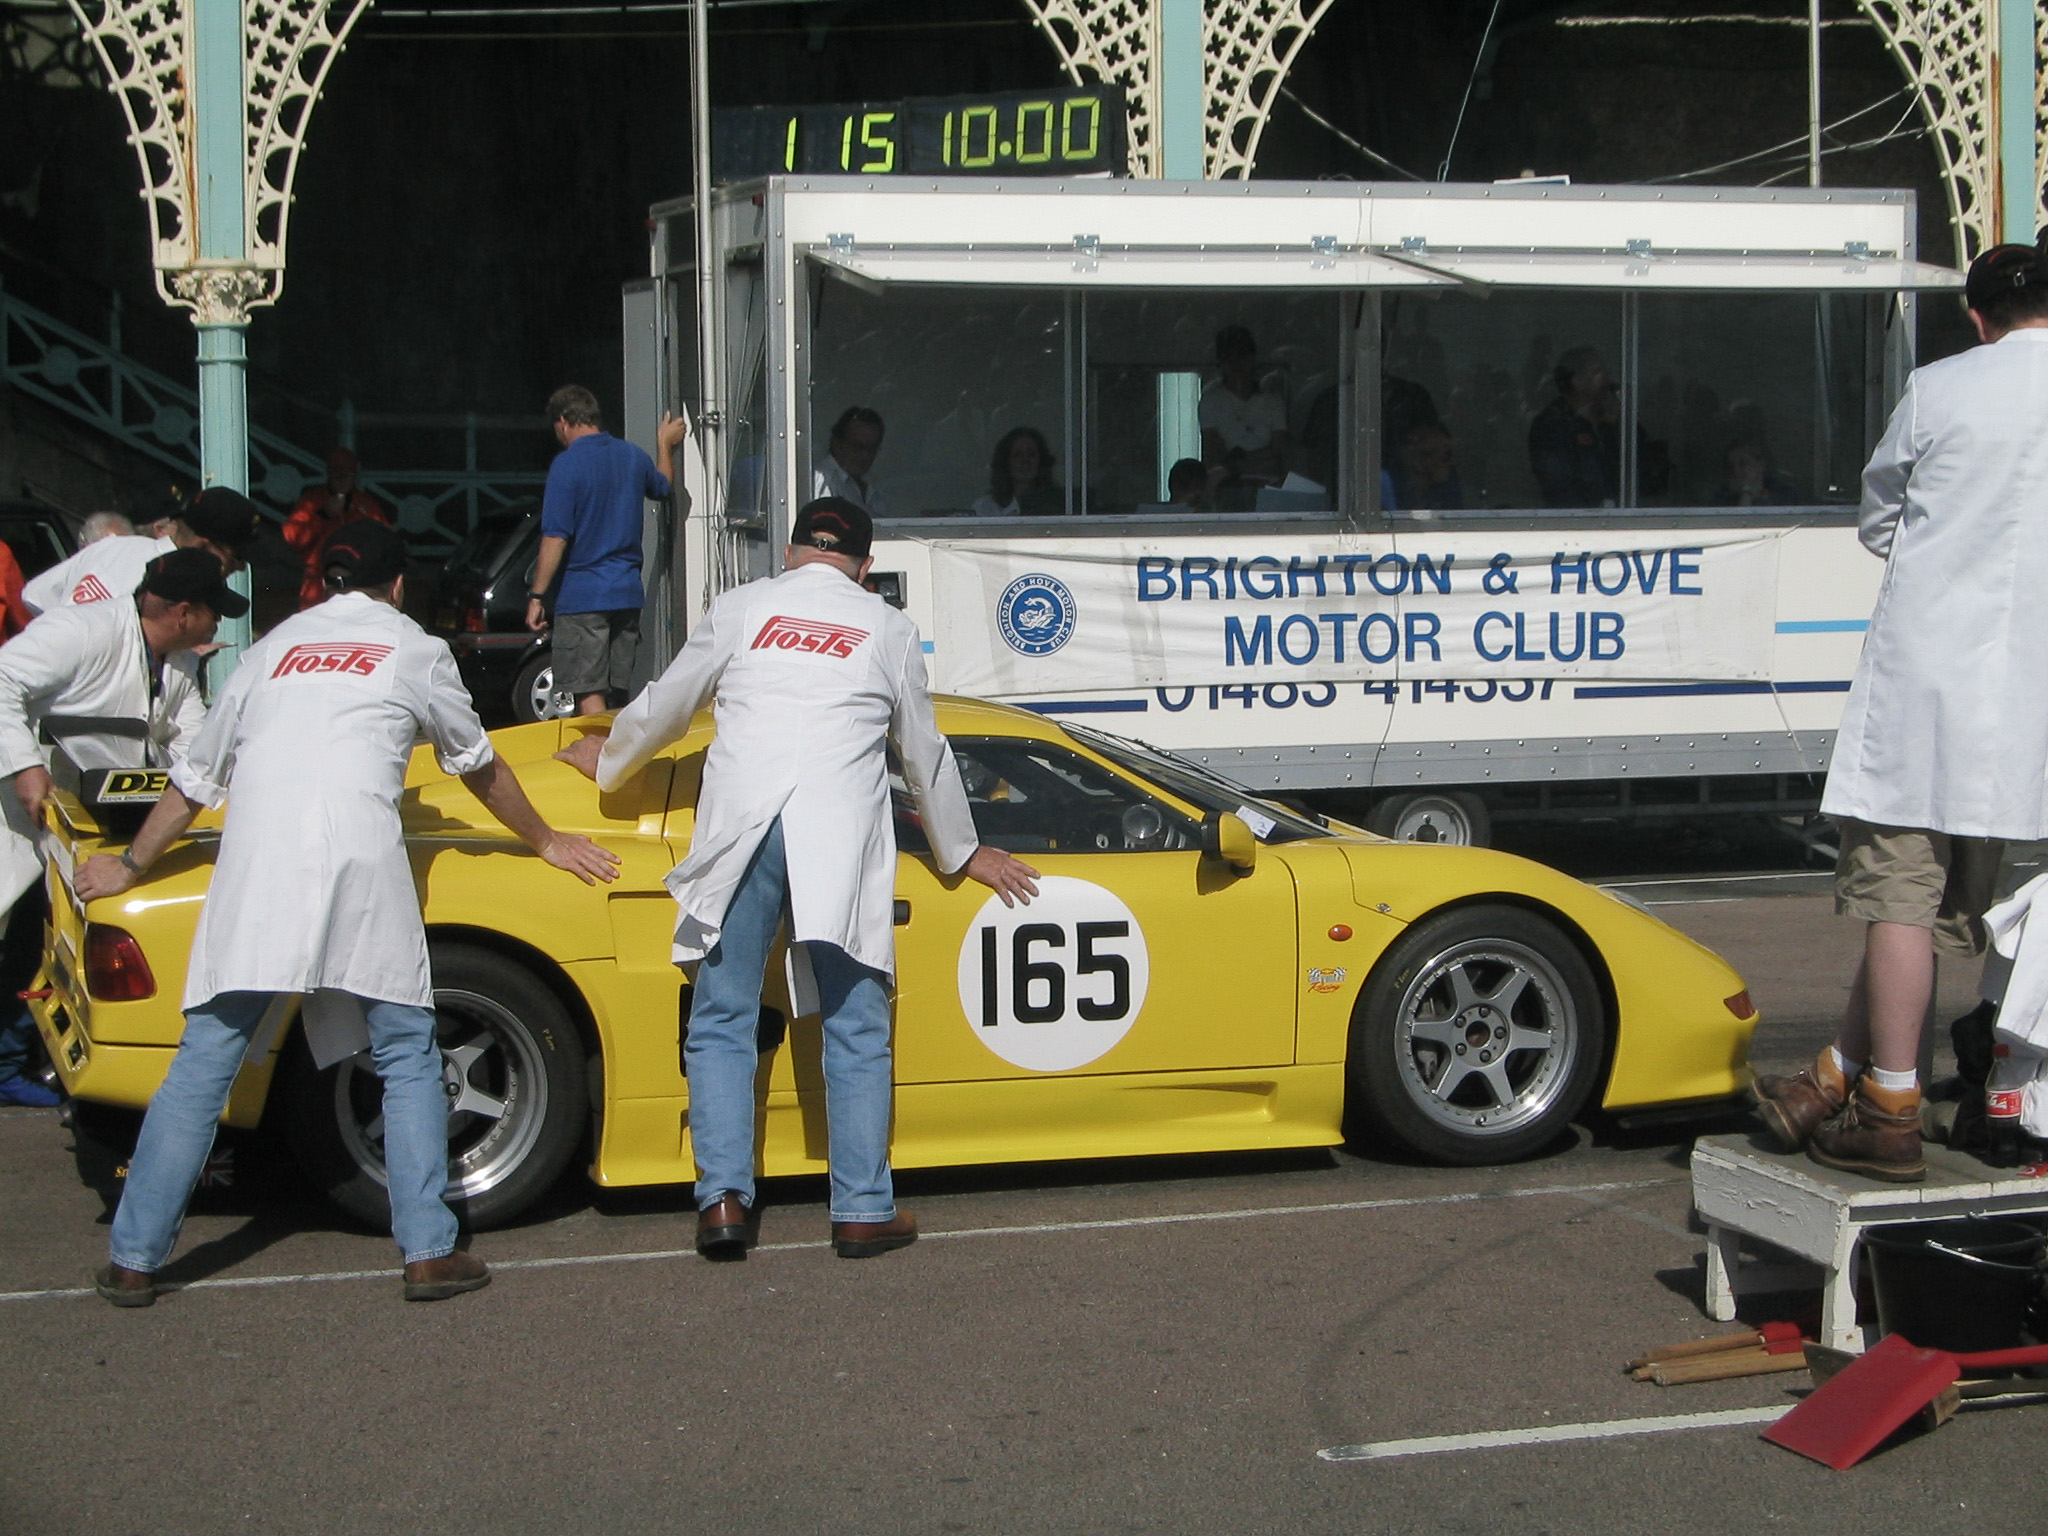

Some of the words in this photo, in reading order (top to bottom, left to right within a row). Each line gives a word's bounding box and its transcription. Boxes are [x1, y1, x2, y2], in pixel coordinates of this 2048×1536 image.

[943, 96, 1100, 168] 10.00
[1008, 581, 1026, 599] AND
[1028, 577, 1056, 590] HOVE
[1137, 553, 1456, 602] BRIGHTON
[1482, 552, 1520, 596] &
[1550, 547, 1704, 596] HOVE
[1001, 602, 1026, 649] BRIGHTON
[1056, 588, 1073, 624] MOTOR
[1050, 627, 1069, 648] CLUB
[1223, 612, 1442, 666] MOTOR
[1473, 610, 1626, 663] CLUB
[107, 772, 169, 793] DE
[981, 919, 1131, 1028] 165
